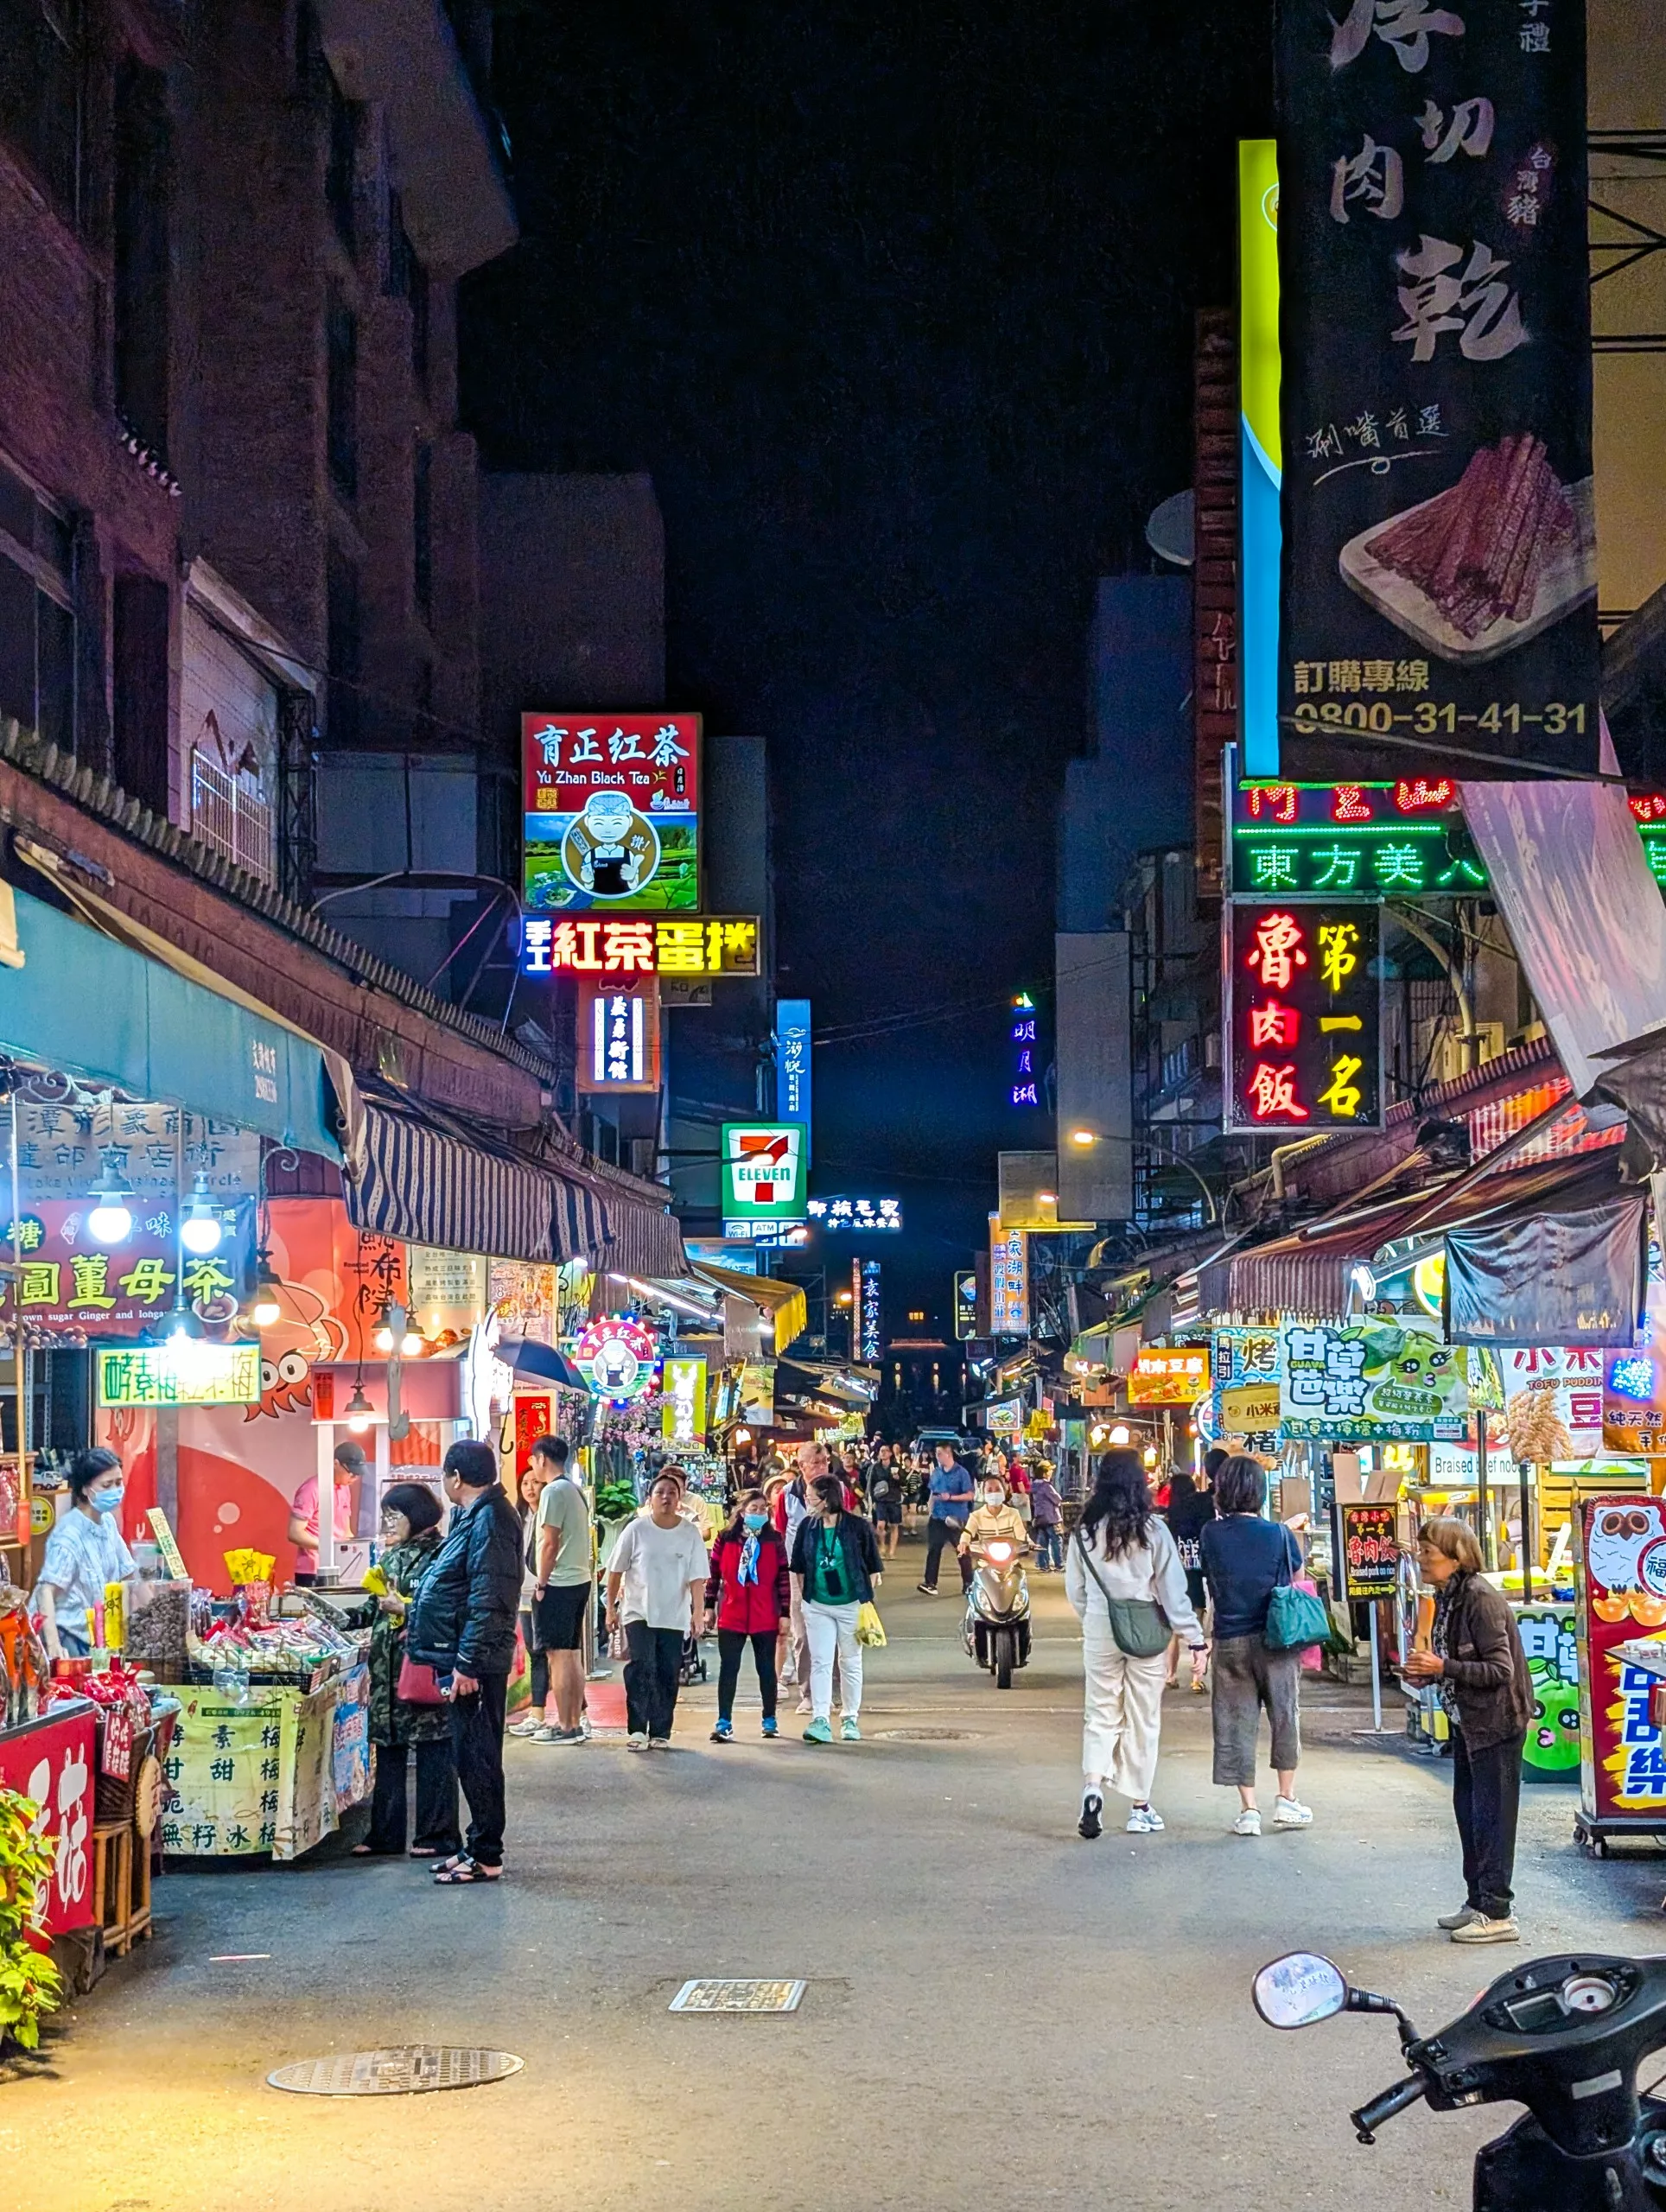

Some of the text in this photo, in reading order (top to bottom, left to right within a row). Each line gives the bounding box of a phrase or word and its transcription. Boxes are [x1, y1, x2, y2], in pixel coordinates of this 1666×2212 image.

[1294, 658, 1430, 693] 訂購專線
[1293, 702, 1587, 735] 0800-31-41-31
[533, 724, 690, 767] 育正紅茶
[537, 770, 551, 784] Yu
[591, 771, 626, 785] Black
[628, 771, 650, 785] Tea
[525, 919, 552, 971] 手工
[552, 921, 755, 972] 紅茶蛋捲
[1248, 912, 1310, 1118] 魯肉飯
[1317, 923, 1364, 1117] 第一名
[1013, 1020, 1038, 1104] 明月湖
[12, 1312, 43, 1322] Bown
[48, 1313, 73, 1323] sugar
[79, 1311, 111, 1322] Ginger
[115, 1310, 133, 1319] and
[862, 1277, 880, 1360] 袁家美食
[1290, 1359, 1326, 1370] GUAVA
[1527, 1378, 1559, 1390] TOFU
[1608, 1410, 1663, 1427] 純天然
[1435, 1456, 1472, 1473] Braised
